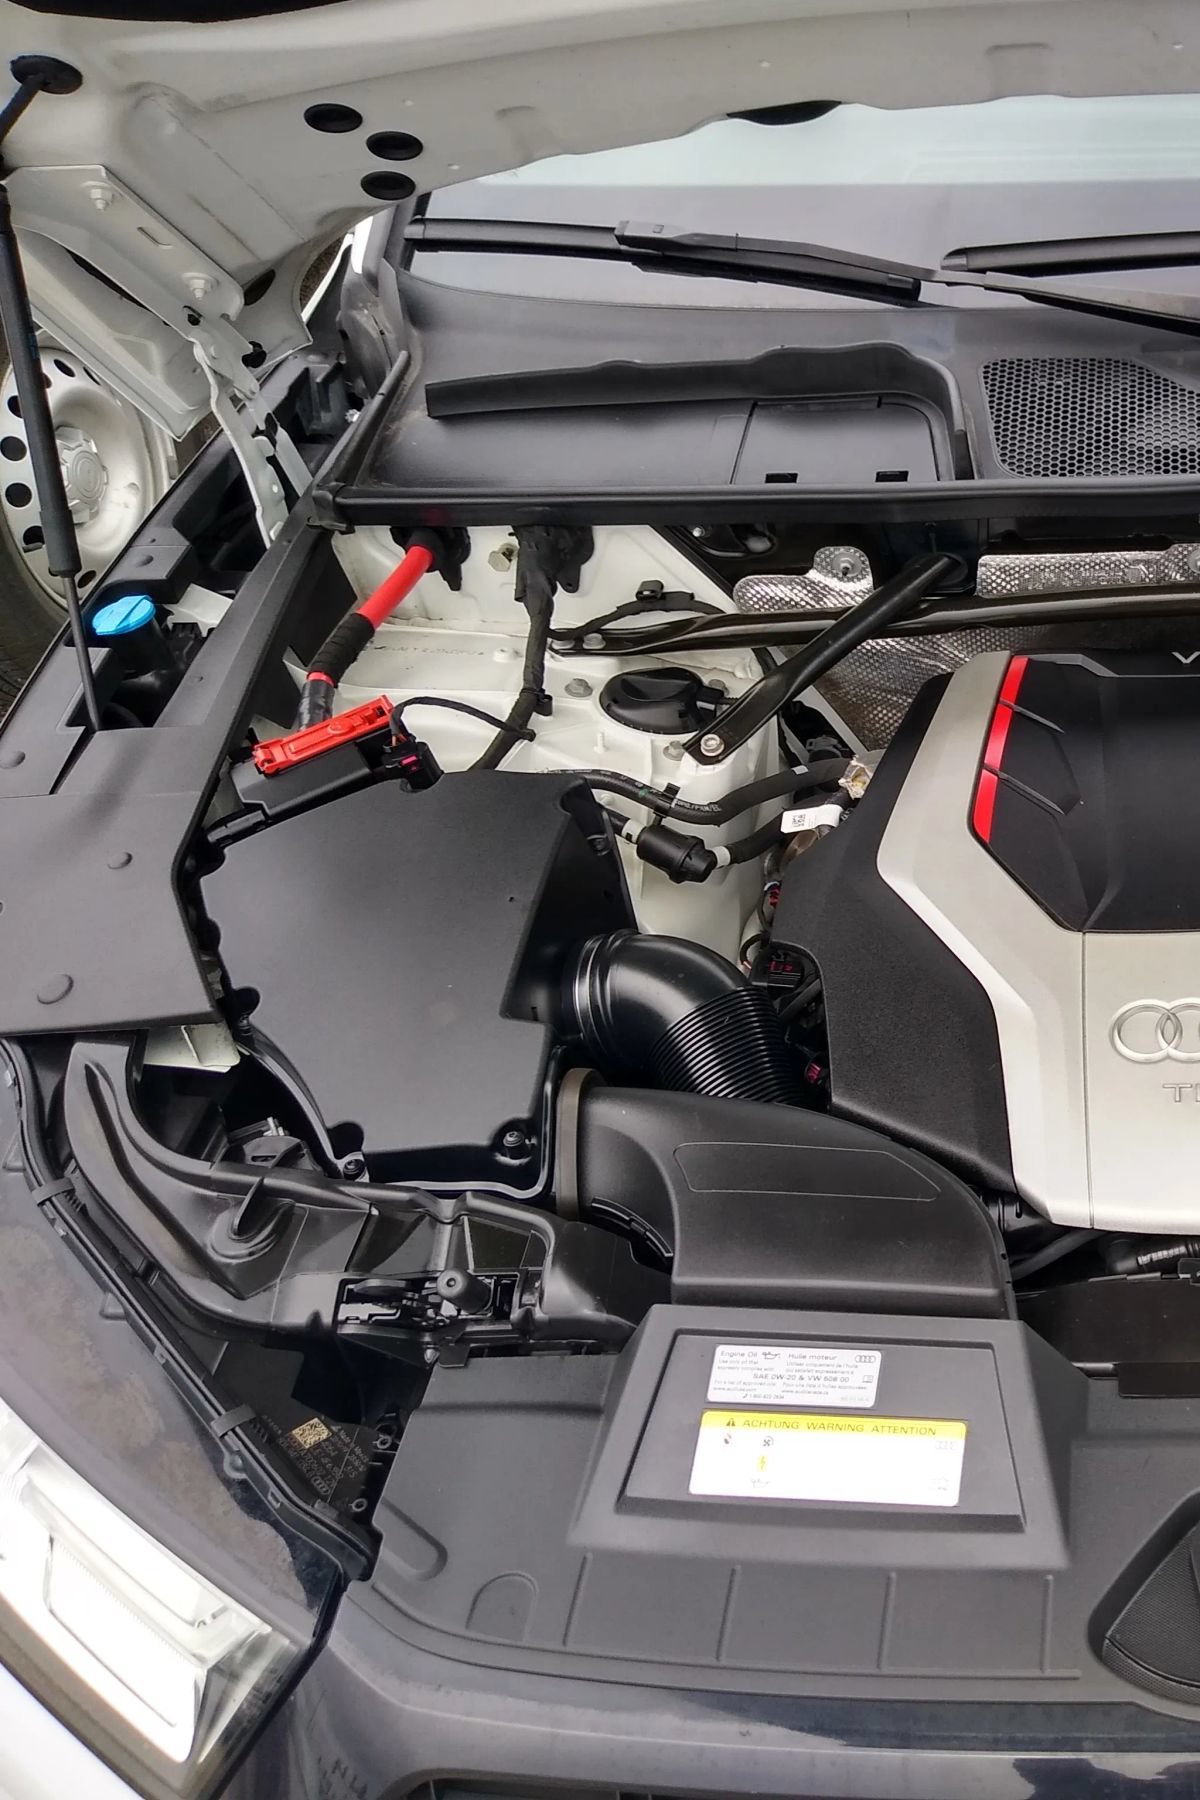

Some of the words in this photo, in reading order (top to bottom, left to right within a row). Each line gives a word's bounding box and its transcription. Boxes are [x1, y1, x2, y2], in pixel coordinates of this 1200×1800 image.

[743, 1419, 799, 1430] ACHTUNG
[806, 1421, 865, 1433] WARNING
[871, 1424, 937, 1436] ATTENTION
